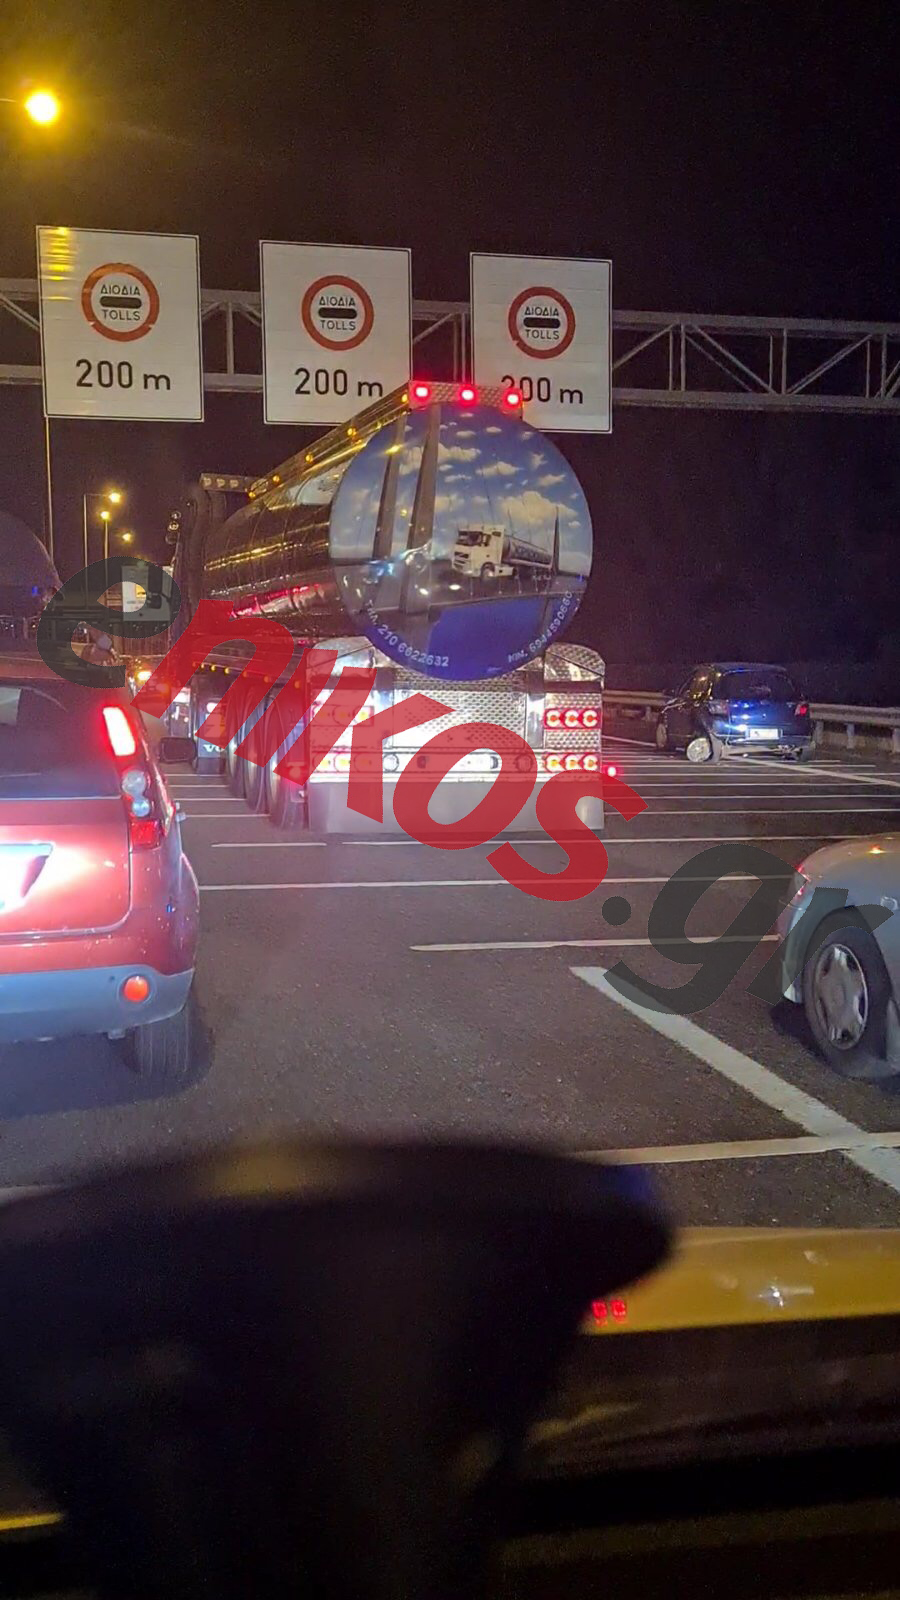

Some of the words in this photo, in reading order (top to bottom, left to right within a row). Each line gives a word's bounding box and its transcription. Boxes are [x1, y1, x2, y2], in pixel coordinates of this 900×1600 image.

[100, 284, 141, 296] ΔΙΟΔΙΑ
[318, 296, 356, 307] ΔΙΟΔΙΑ
[101, 309, 141, 321] TOLLS
[524, 306, 560, 316] ΔΙΟΔΙΑ
[320, 320, 357, 331] TOLLS
[525, 329, 560, 340] TOLLS
[76, 358, 133, 389] 200
[143, 373, 171, 390] m
[294, 367, 348, 396] 200
[357, 381, 383, 397] m
[559, 388, 583, 404] m
[398, 642, 449, 667] 6622632
